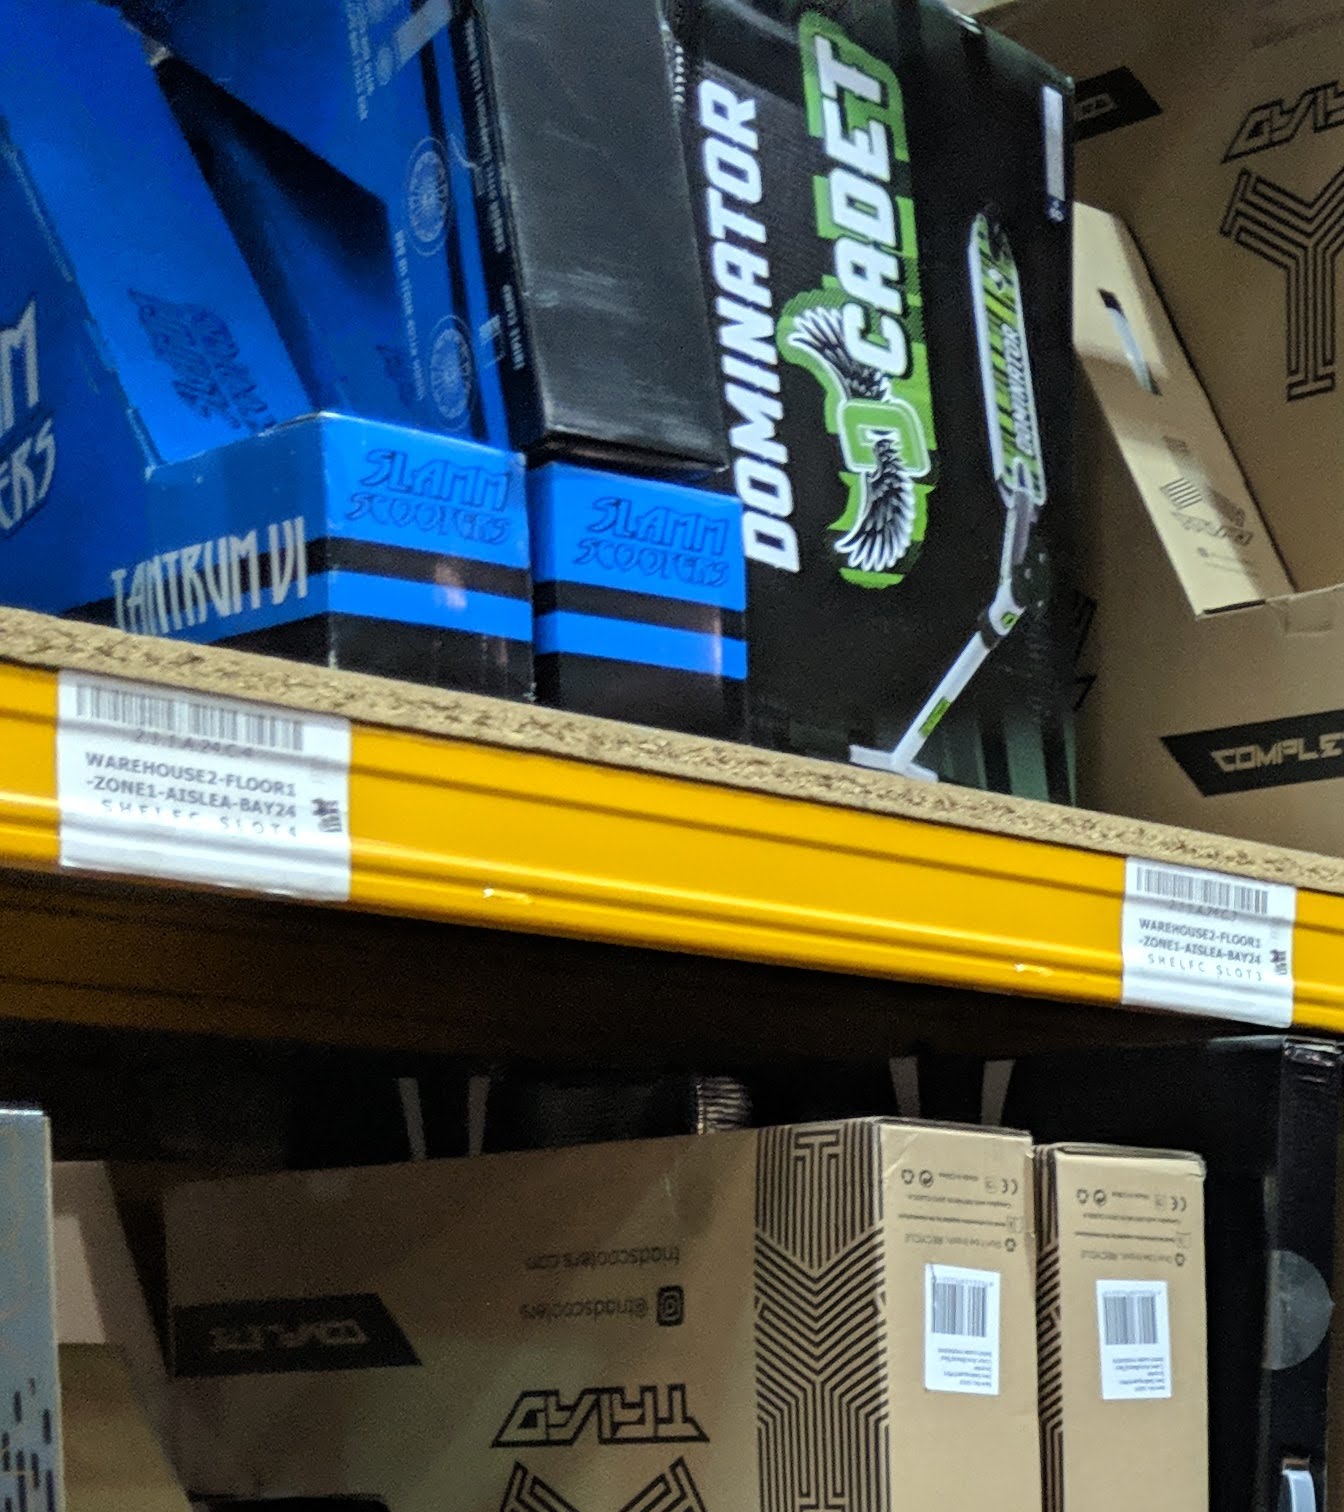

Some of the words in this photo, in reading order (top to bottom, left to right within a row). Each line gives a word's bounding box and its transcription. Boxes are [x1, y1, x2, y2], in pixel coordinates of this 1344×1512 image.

[814, 36, 908, 378] CADET
[699, 78, 800, 572] DOMINATOR
[360, 449, 512, 511] SLAMM
[347, 492, 511, 546] SCOOTERS
[587, 497, 729, 556] SLAMM
[111, 529, 260, 634] TANTRUM
[573, 537, 729, 588] SCOOTERS
[86, 751, 297, 797] WAREHOUSE2-FLOOR1
[86, 775, 297, 818] -ZONE1-AISLEA-BAY24
[1139, 918, 1262, 949] WAREHOUSE2-FLOOR1
[490, 1383, 711, 1448] TRIAD
